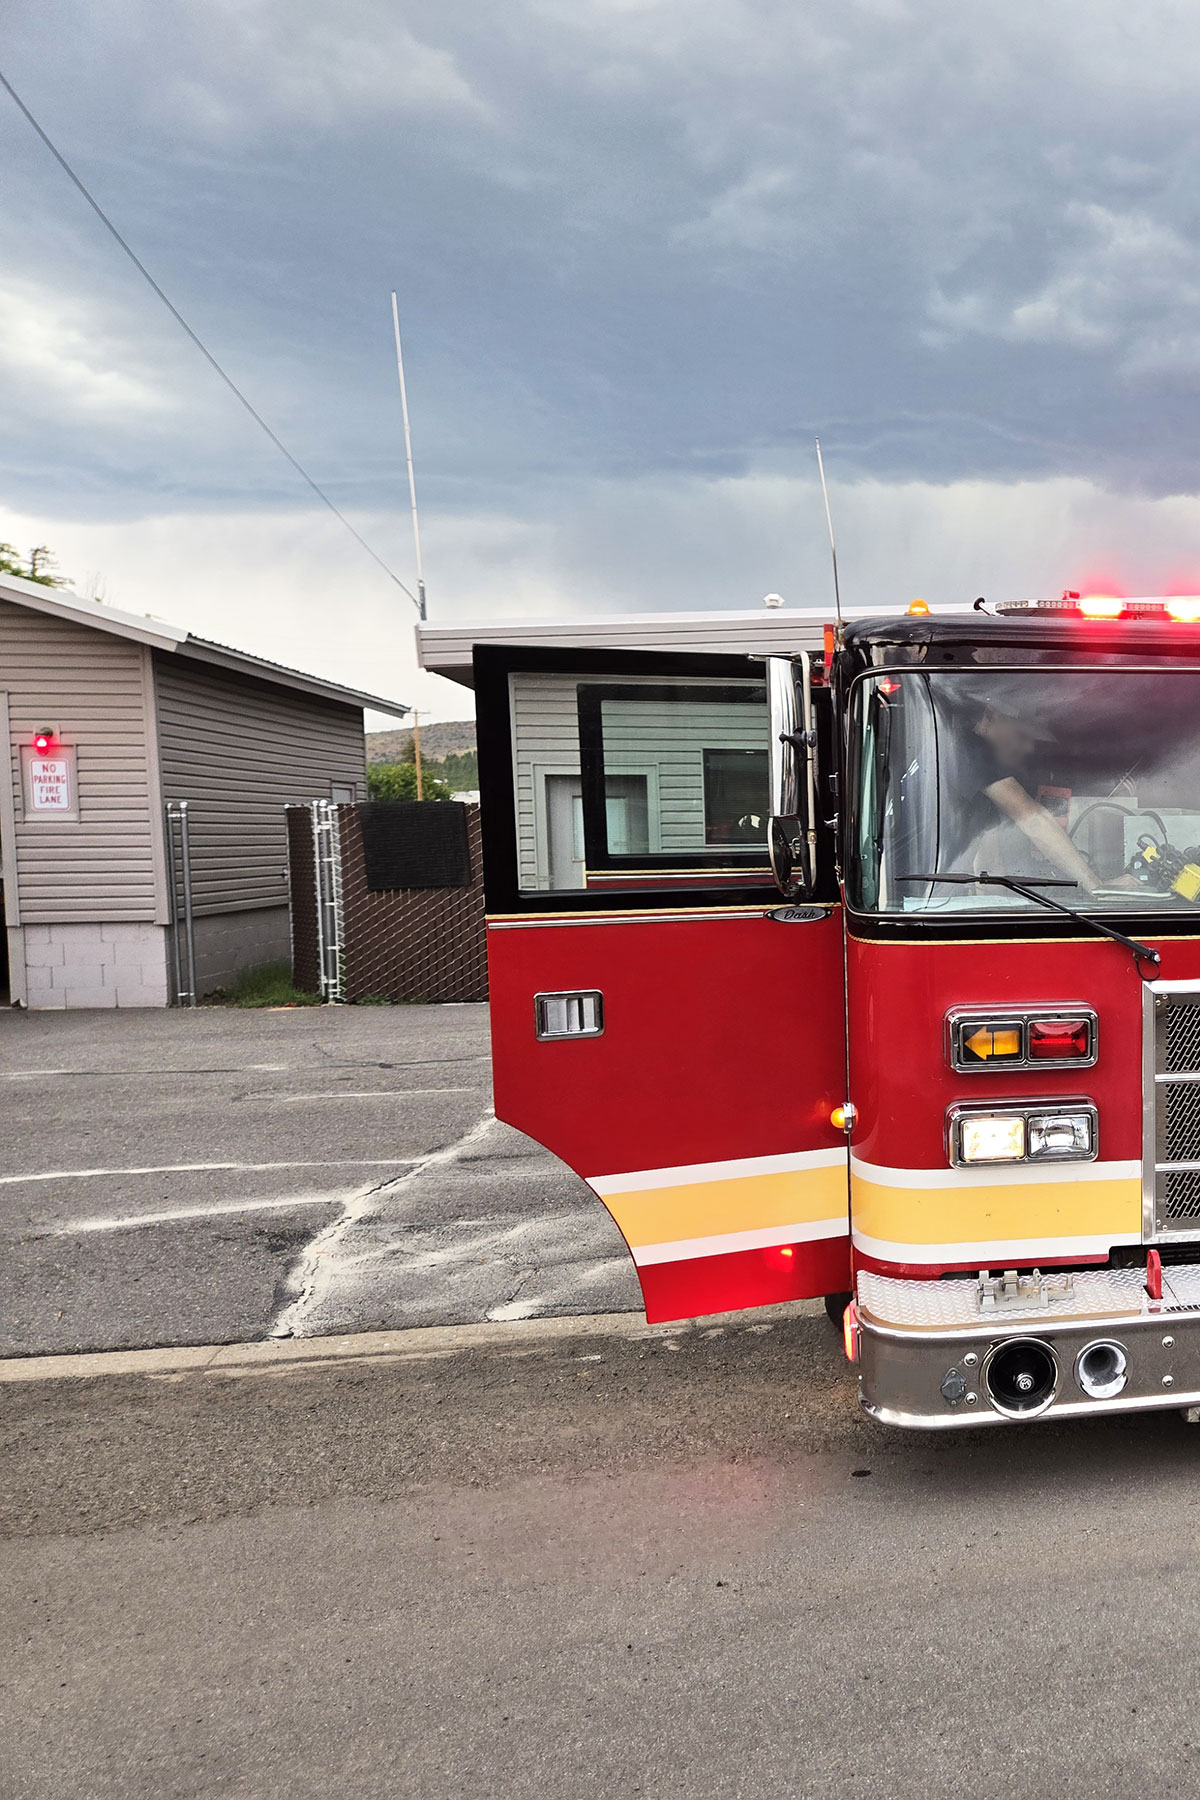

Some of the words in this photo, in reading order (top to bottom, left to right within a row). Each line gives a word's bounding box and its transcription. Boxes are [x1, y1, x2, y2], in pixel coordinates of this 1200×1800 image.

[42, 764, 57, 773] NO
[34, 775, 66, 784] PARKING
[40, 786, 61, 794] FIRE
[40, 796, 62, 804] LANE
[784, 909, 816, 919] Dash
